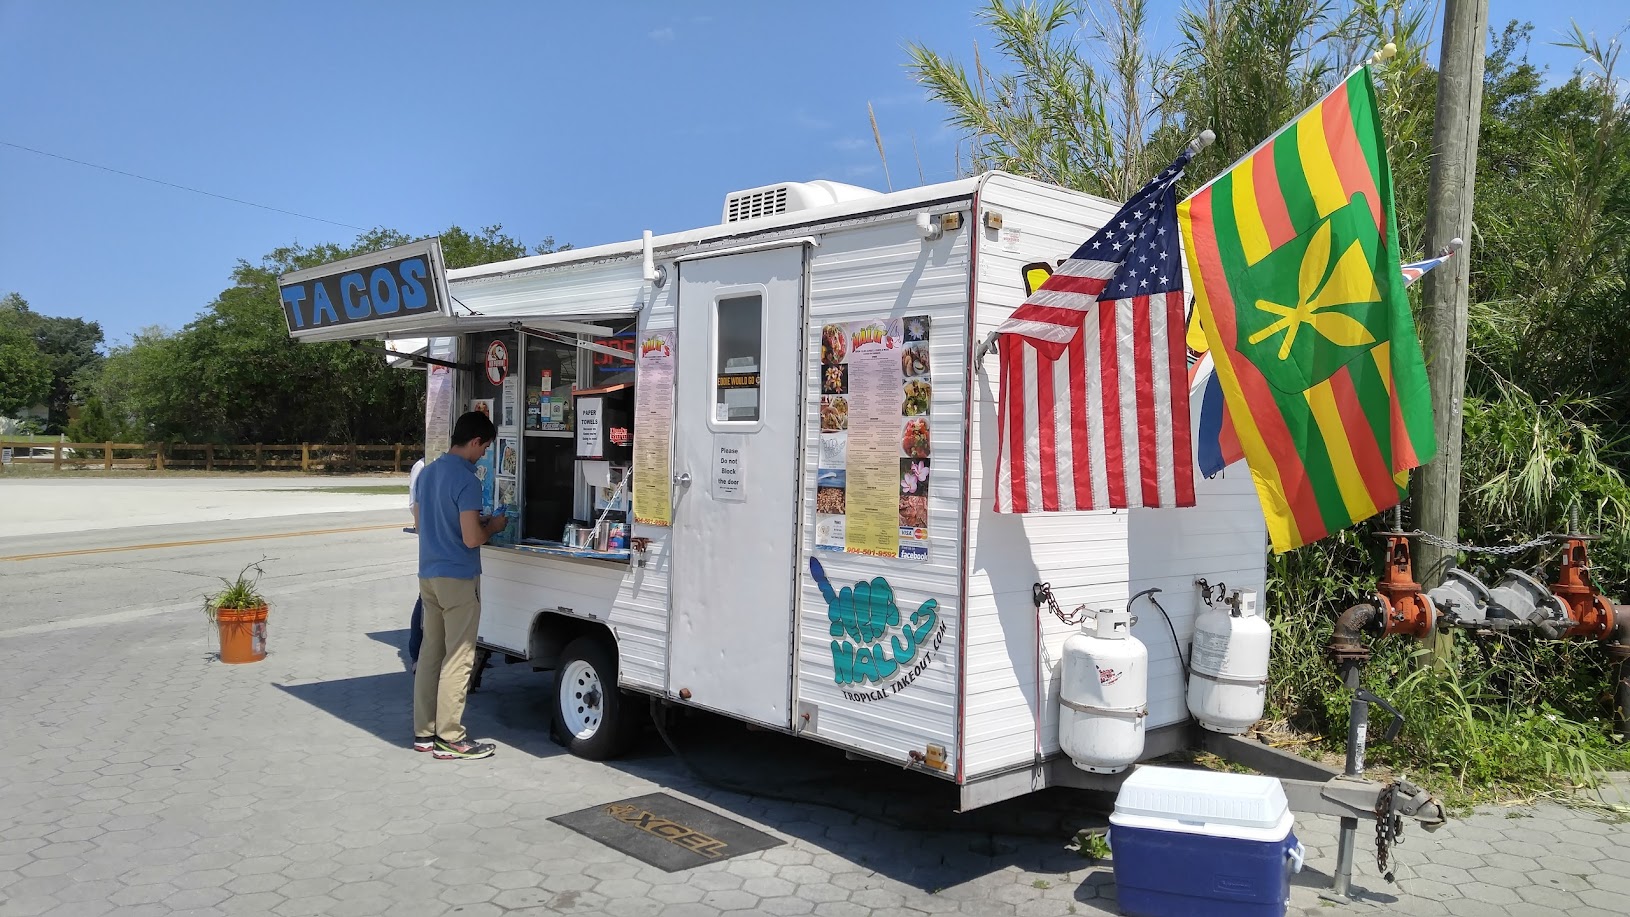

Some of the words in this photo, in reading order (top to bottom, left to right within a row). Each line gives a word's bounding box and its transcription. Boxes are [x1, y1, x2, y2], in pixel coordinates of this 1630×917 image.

[282, 259, 427, 327] TACOS
[594, 339, 635, 365] OPE
[718, 377, 731, 385] EDDIE
[731, 376, 748, 385] WOULD
[748, 376, 755, 385] GO
[846, 548, 896, 558] 904-501-9592
[900, 550, 928, 561] facebook
[831, 599, 939, 685] NALU'S
[842, 689, 889, 703] TROPICAL
